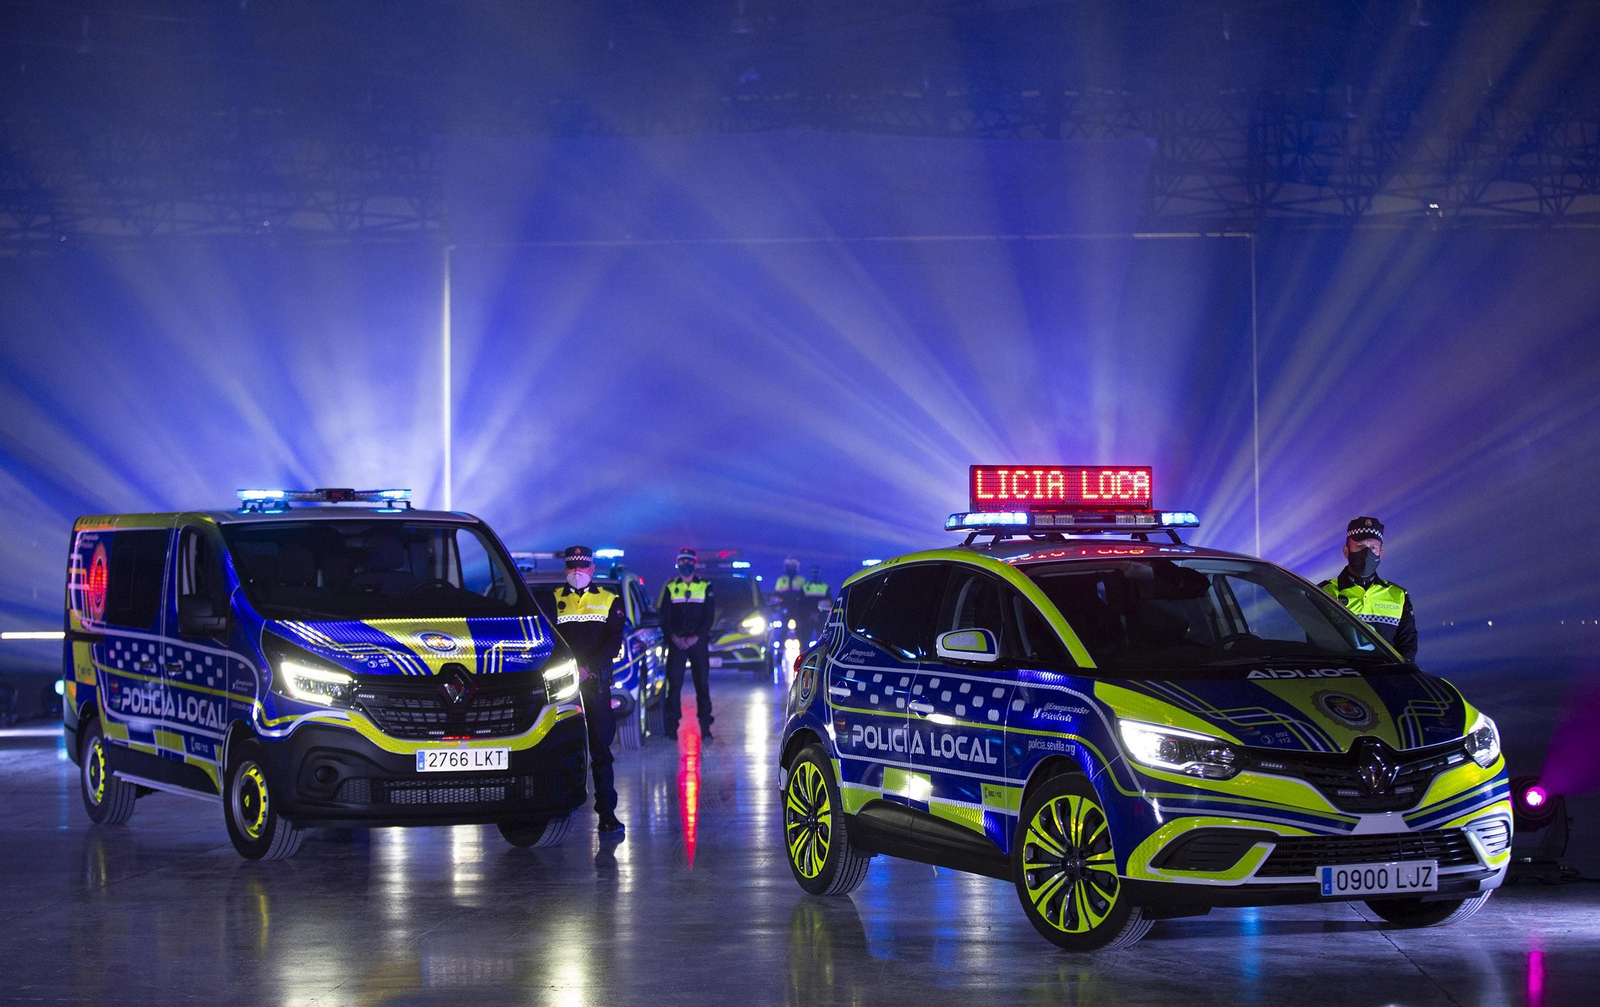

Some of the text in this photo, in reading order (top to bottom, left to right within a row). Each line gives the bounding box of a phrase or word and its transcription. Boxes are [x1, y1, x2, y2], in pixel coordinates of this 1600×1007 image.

[976, 469, 1150, 500] LICIA LOCA
[177, 693, 228, 731] LOCAL
[428, 751, 469, 768] 2766
[474, 750, 504, 767] LKT
[852, 723, 998, 765] POLICÍA LOCAL
[1336, 868, 1389, 891] 0900
[1396, 866, 1433, 889] LJZ
